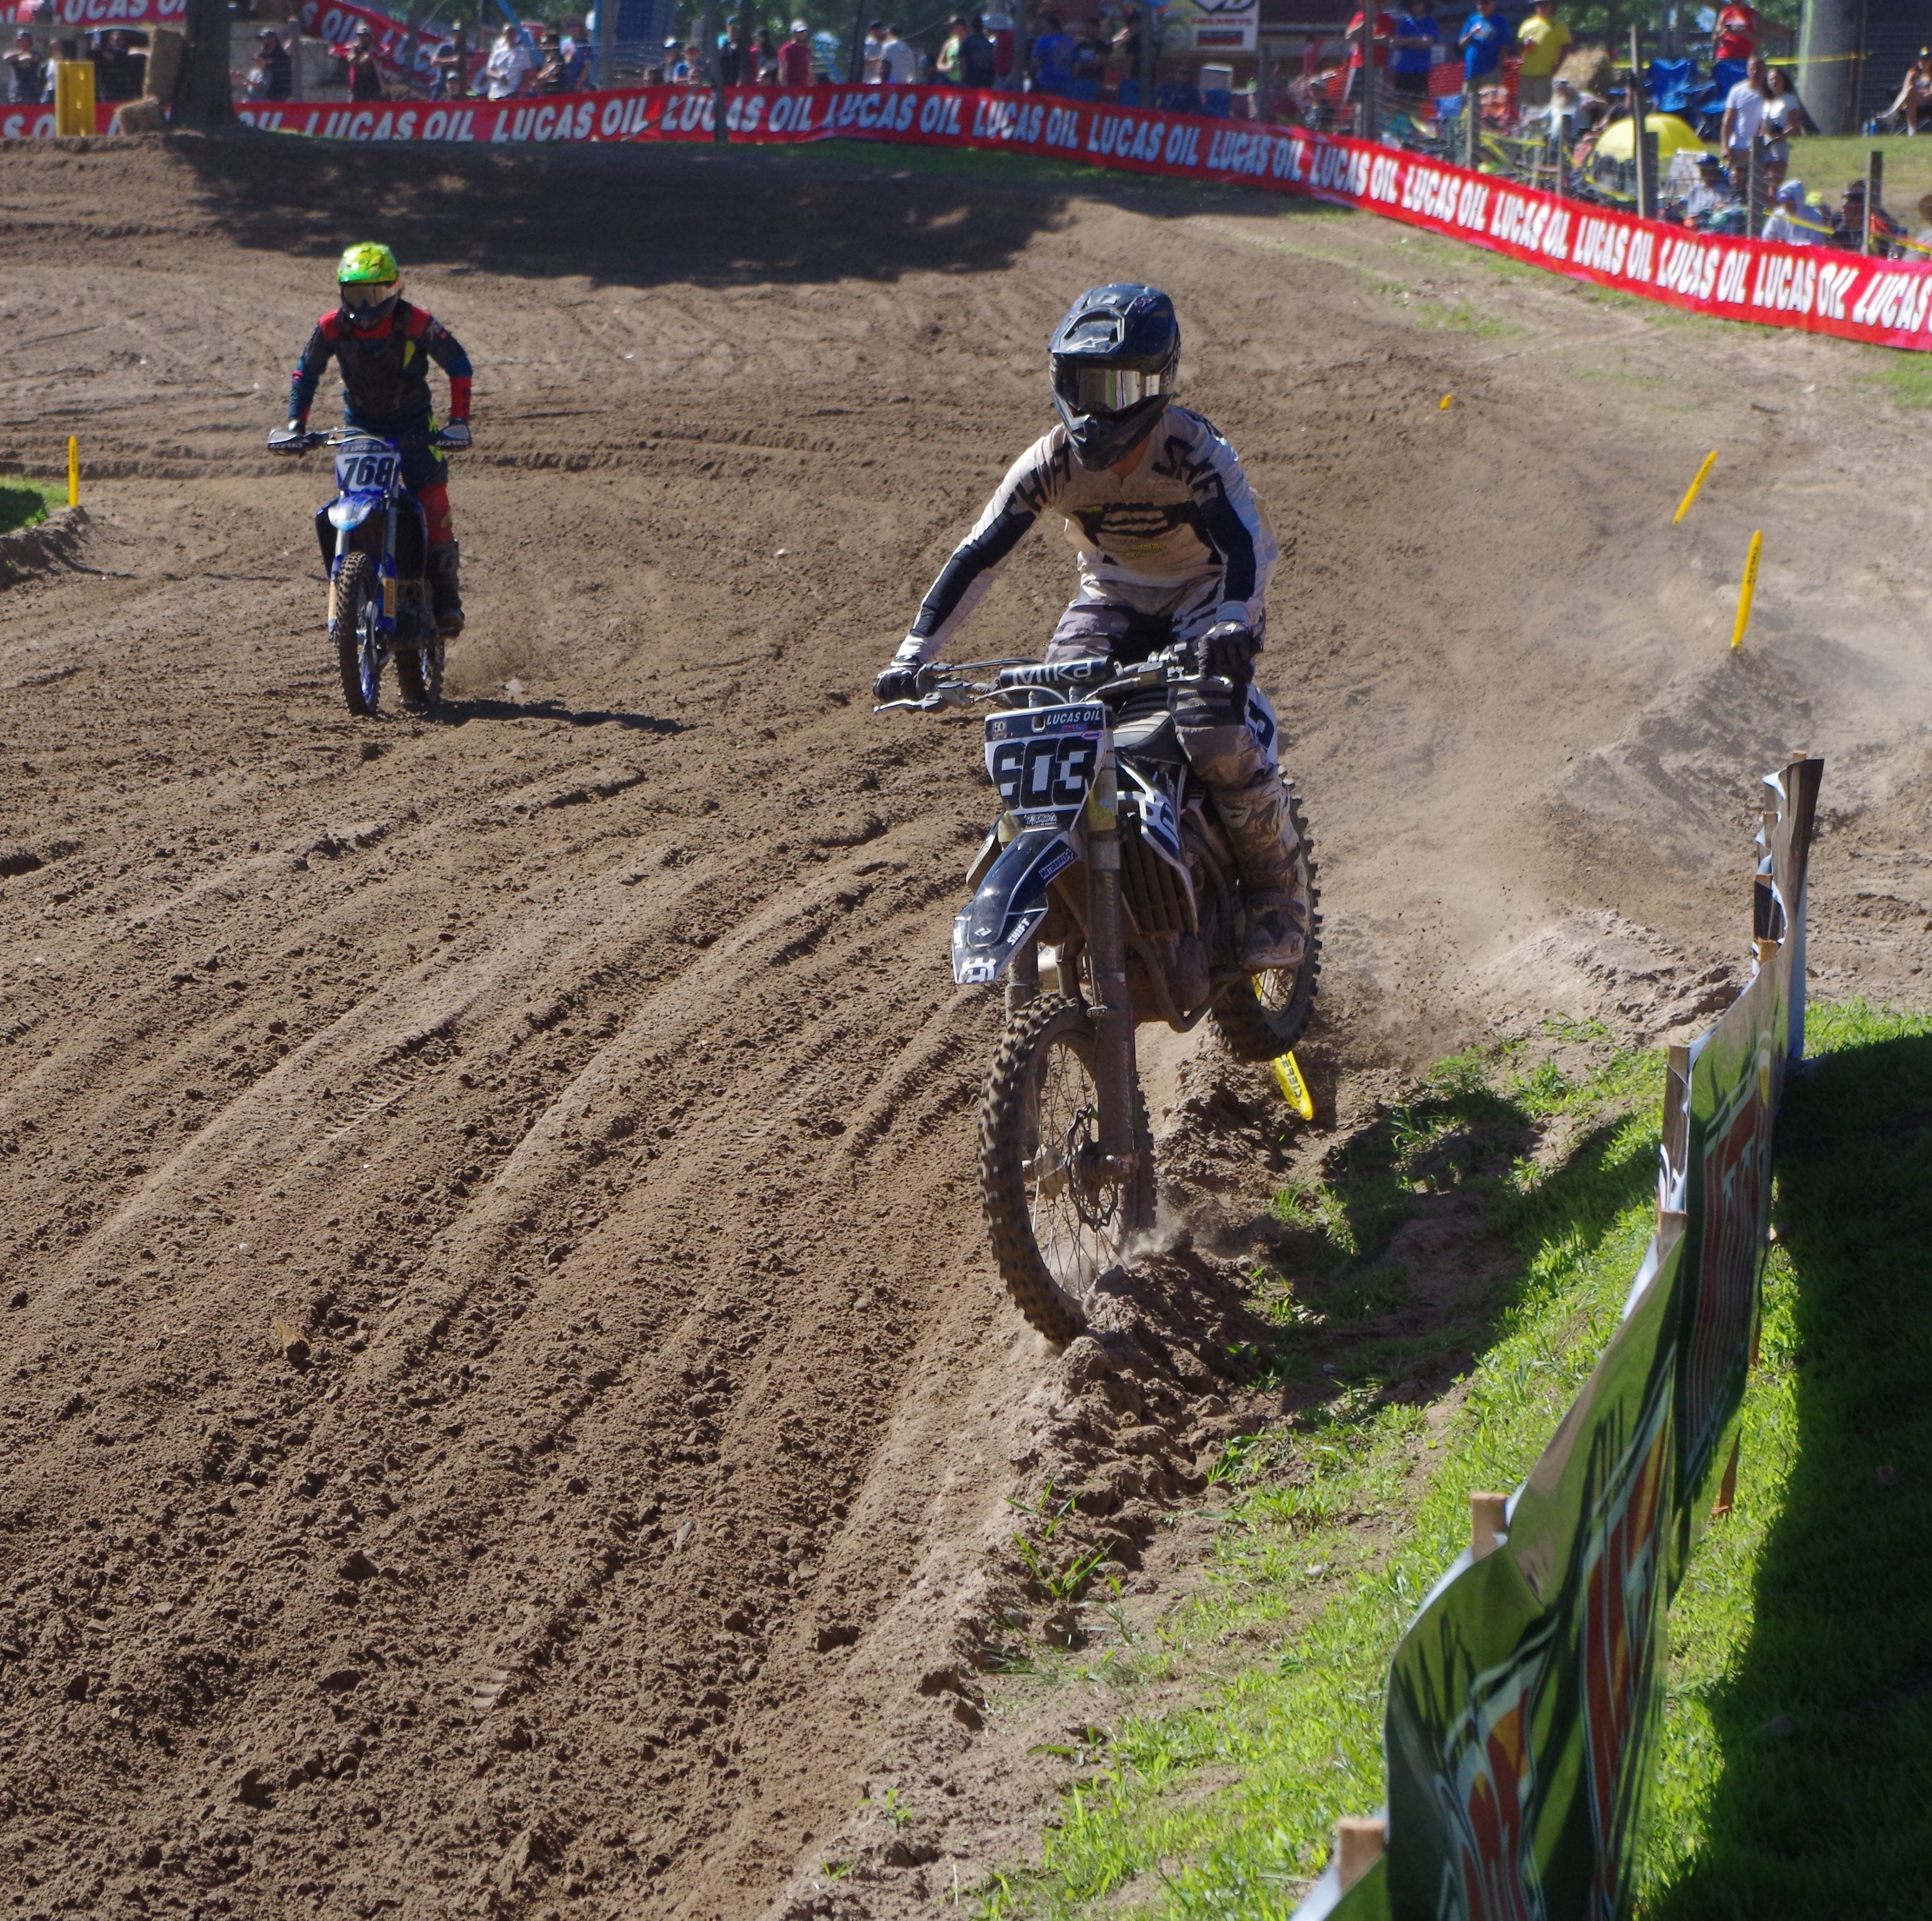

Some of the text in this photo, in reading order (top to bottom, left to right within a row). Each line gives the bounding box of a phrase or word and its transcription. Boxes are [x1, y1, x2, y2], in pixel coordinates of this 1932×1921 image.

[305, 111, 416, 141] LUCAS
[423, 110, 475, 141] OIL
[491, 102, 596, 143] LUCAS
[601, 97, 649, 137] OIL
[768, 95, 814, 133] OIL
[821, 92, 917, 132] LUCAS
[919, 94, 962, 135] OIL
[972, 98, 1045, 145] LUCAS
[1045, 107, 1079, 149] OIL
[1087, 114, 1166, 162] LUCAS
[1165, 123, 1201, 167] OIL
[1206, 129, 1272, 176] LUCAS
[1272, 137, 1305, 181] OIL
[1308, 145, 1371, 197] LUCAS
[1369, 154, 1399, 204] OIL
[1401, 164, 1461, 223] LUCAS
[1457, 179, 1489, 231] OIL
[1490, 191, 1550, 251] LUCAS
[1542, 207, 1571, 260] OIL
[1572, 215, 1630, 276] LUCAS
[1627, 228, 1654, 282] OIL
[1656, 238, 1720, 300] LUCAS
[1717, 250, 1751, 304] OIL
[1752, 253, 1816, 315] LUCAS
[1817, 262, 1860, 320] OIL
[1851, 271, 1932, 334] LUCAS
[341, 456, 395, 488] 768
[1046, 710, 1100, 725] LUCAS OIL
[1007, 918, 1030, 946] SHIFT
